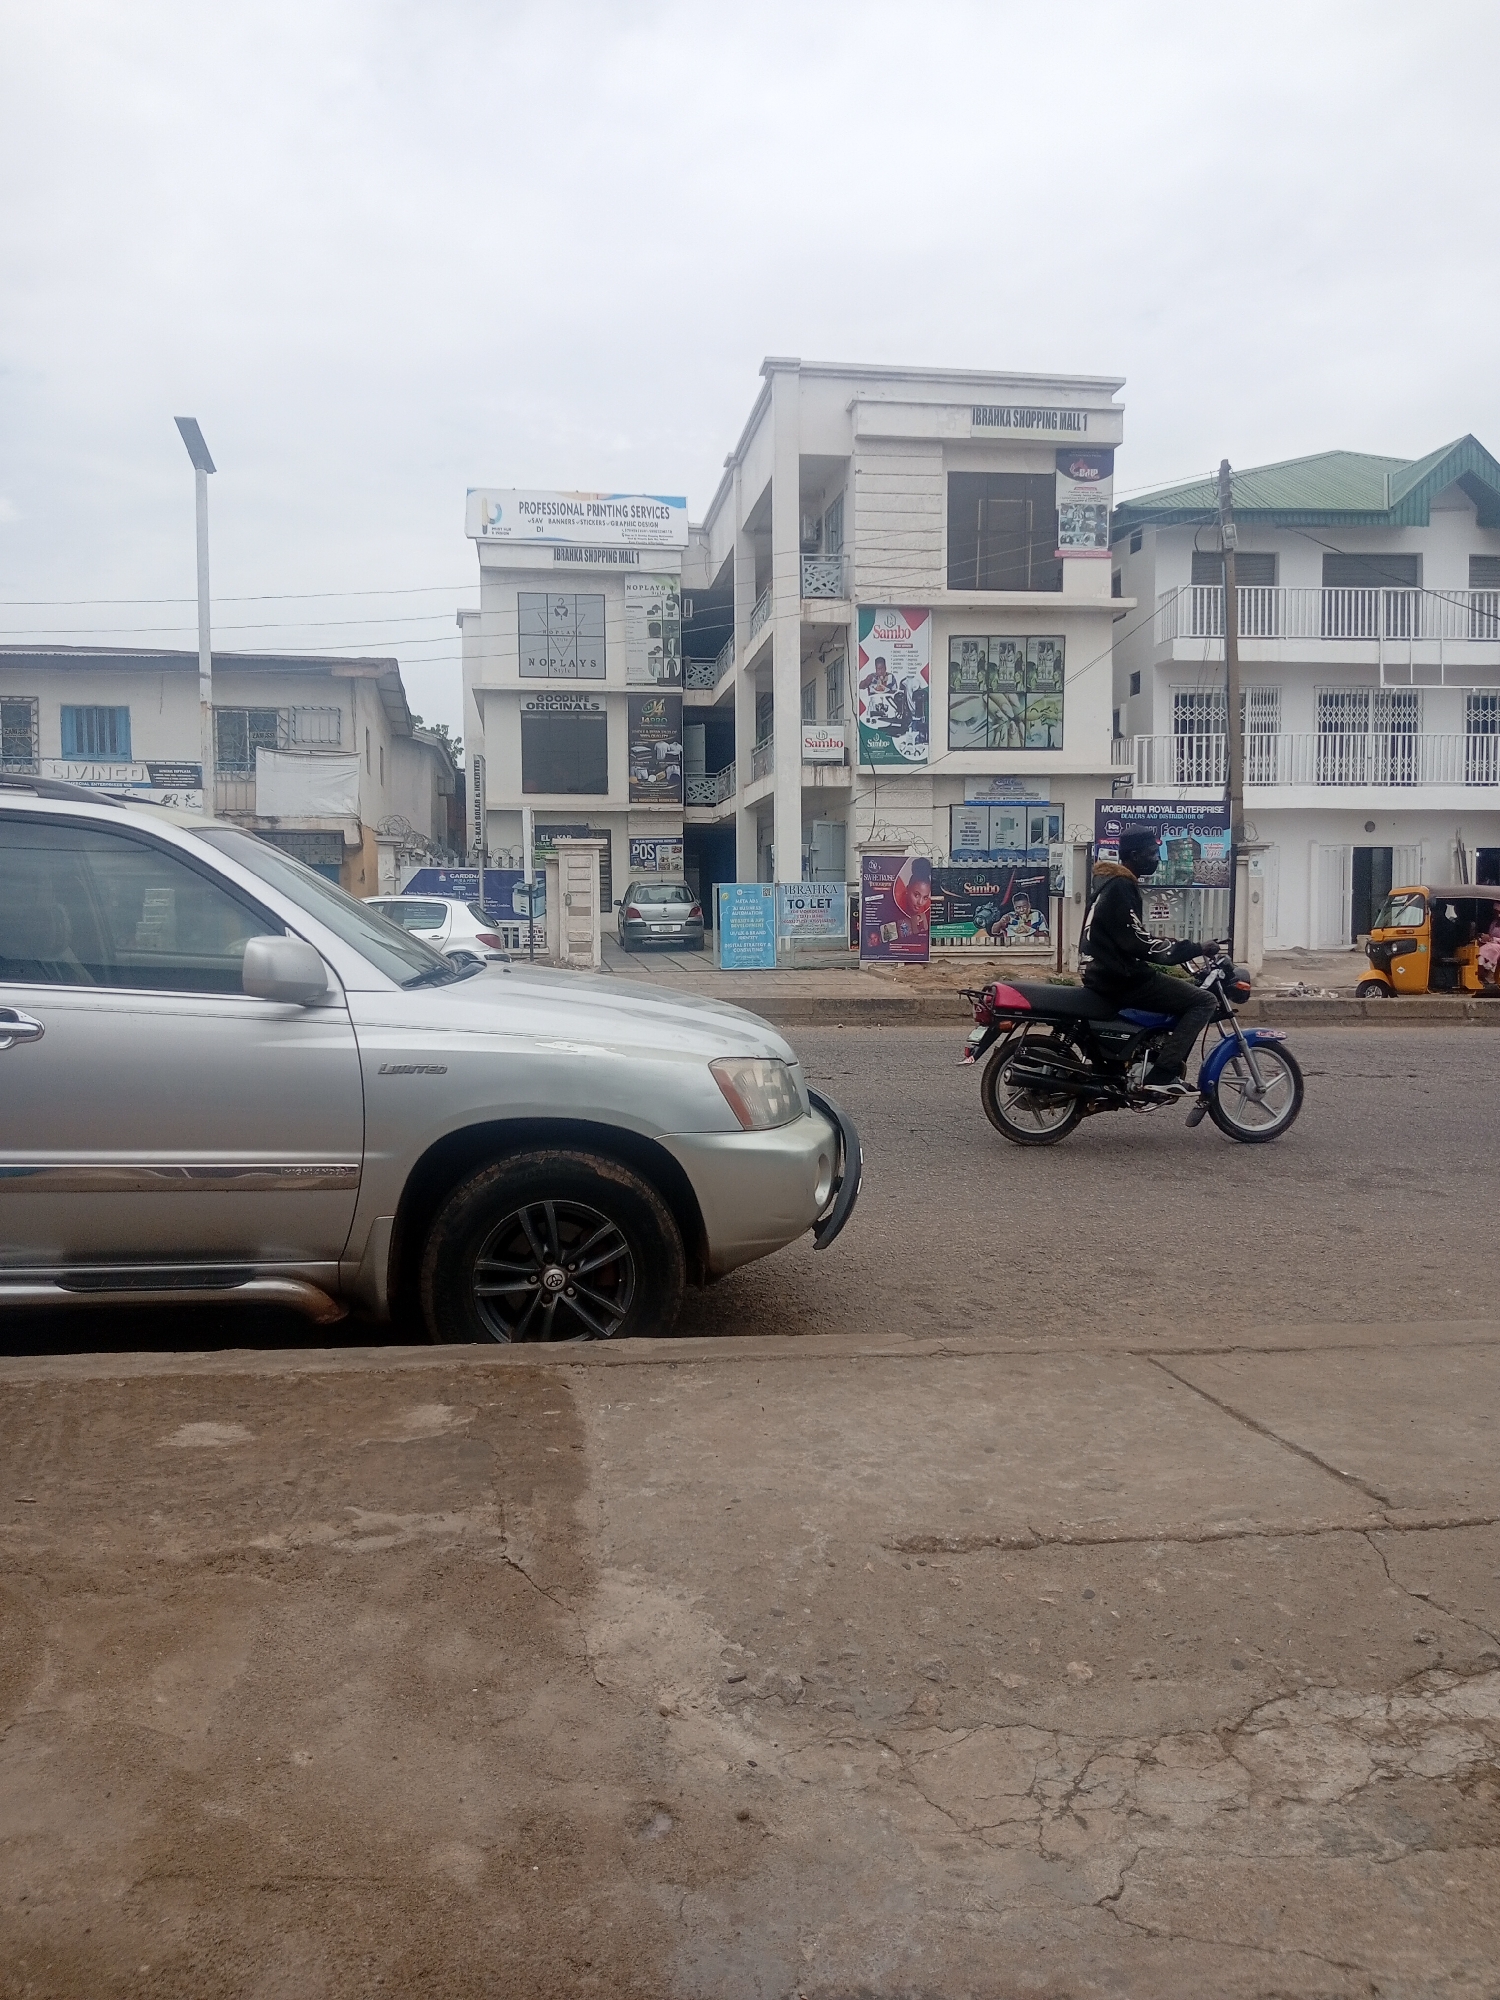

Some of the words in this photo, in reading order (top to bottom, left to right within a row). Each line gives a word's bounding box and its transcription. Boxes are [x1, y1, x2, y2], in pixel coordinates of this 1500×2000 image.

[972, 407, 1012, 428] IBRAHKA
[1013, 410, 1058, 430] SHOPPING
[1059, 413, 1081, 431] MALL
[1083, 414, 1088, 431] 1
[519, 502, 584, 516] PROFESSIONAL
[587, 504, 628, 518] PRINTING
[631, 505, 670, 519] SERVICES
[554, 548, 583, 561] IBRAHKA
[584, 549, 617, 563] SHOPPING
[619, 550, 635, 564] MALL
[636, 551, 640, 564] 1
[873, 625, 911, 639] Sambo
[528, 658, 597, 667] NOPLAYS
[526, 702, 600, 710] ORIGINALS
[805, 738, 843, 748] Sambo
[867, 739, 888, 747] Sambo
[1101, 805, 1147, 813] MOIBRAHIM
[1149, 805, 1174, 813] ROYAL
[1176, 805, 1224, 813] ENTERPRISE
[632, 844, 655, 859] POS
[784, 884, 838, 894] IBRAHKA
[964, 882, 1000, 894] Sambo
[787, 899, 805, 909] TO
[810, 899, 832, 909] LET
[378, 1062, 448, 1075] LIMITED
